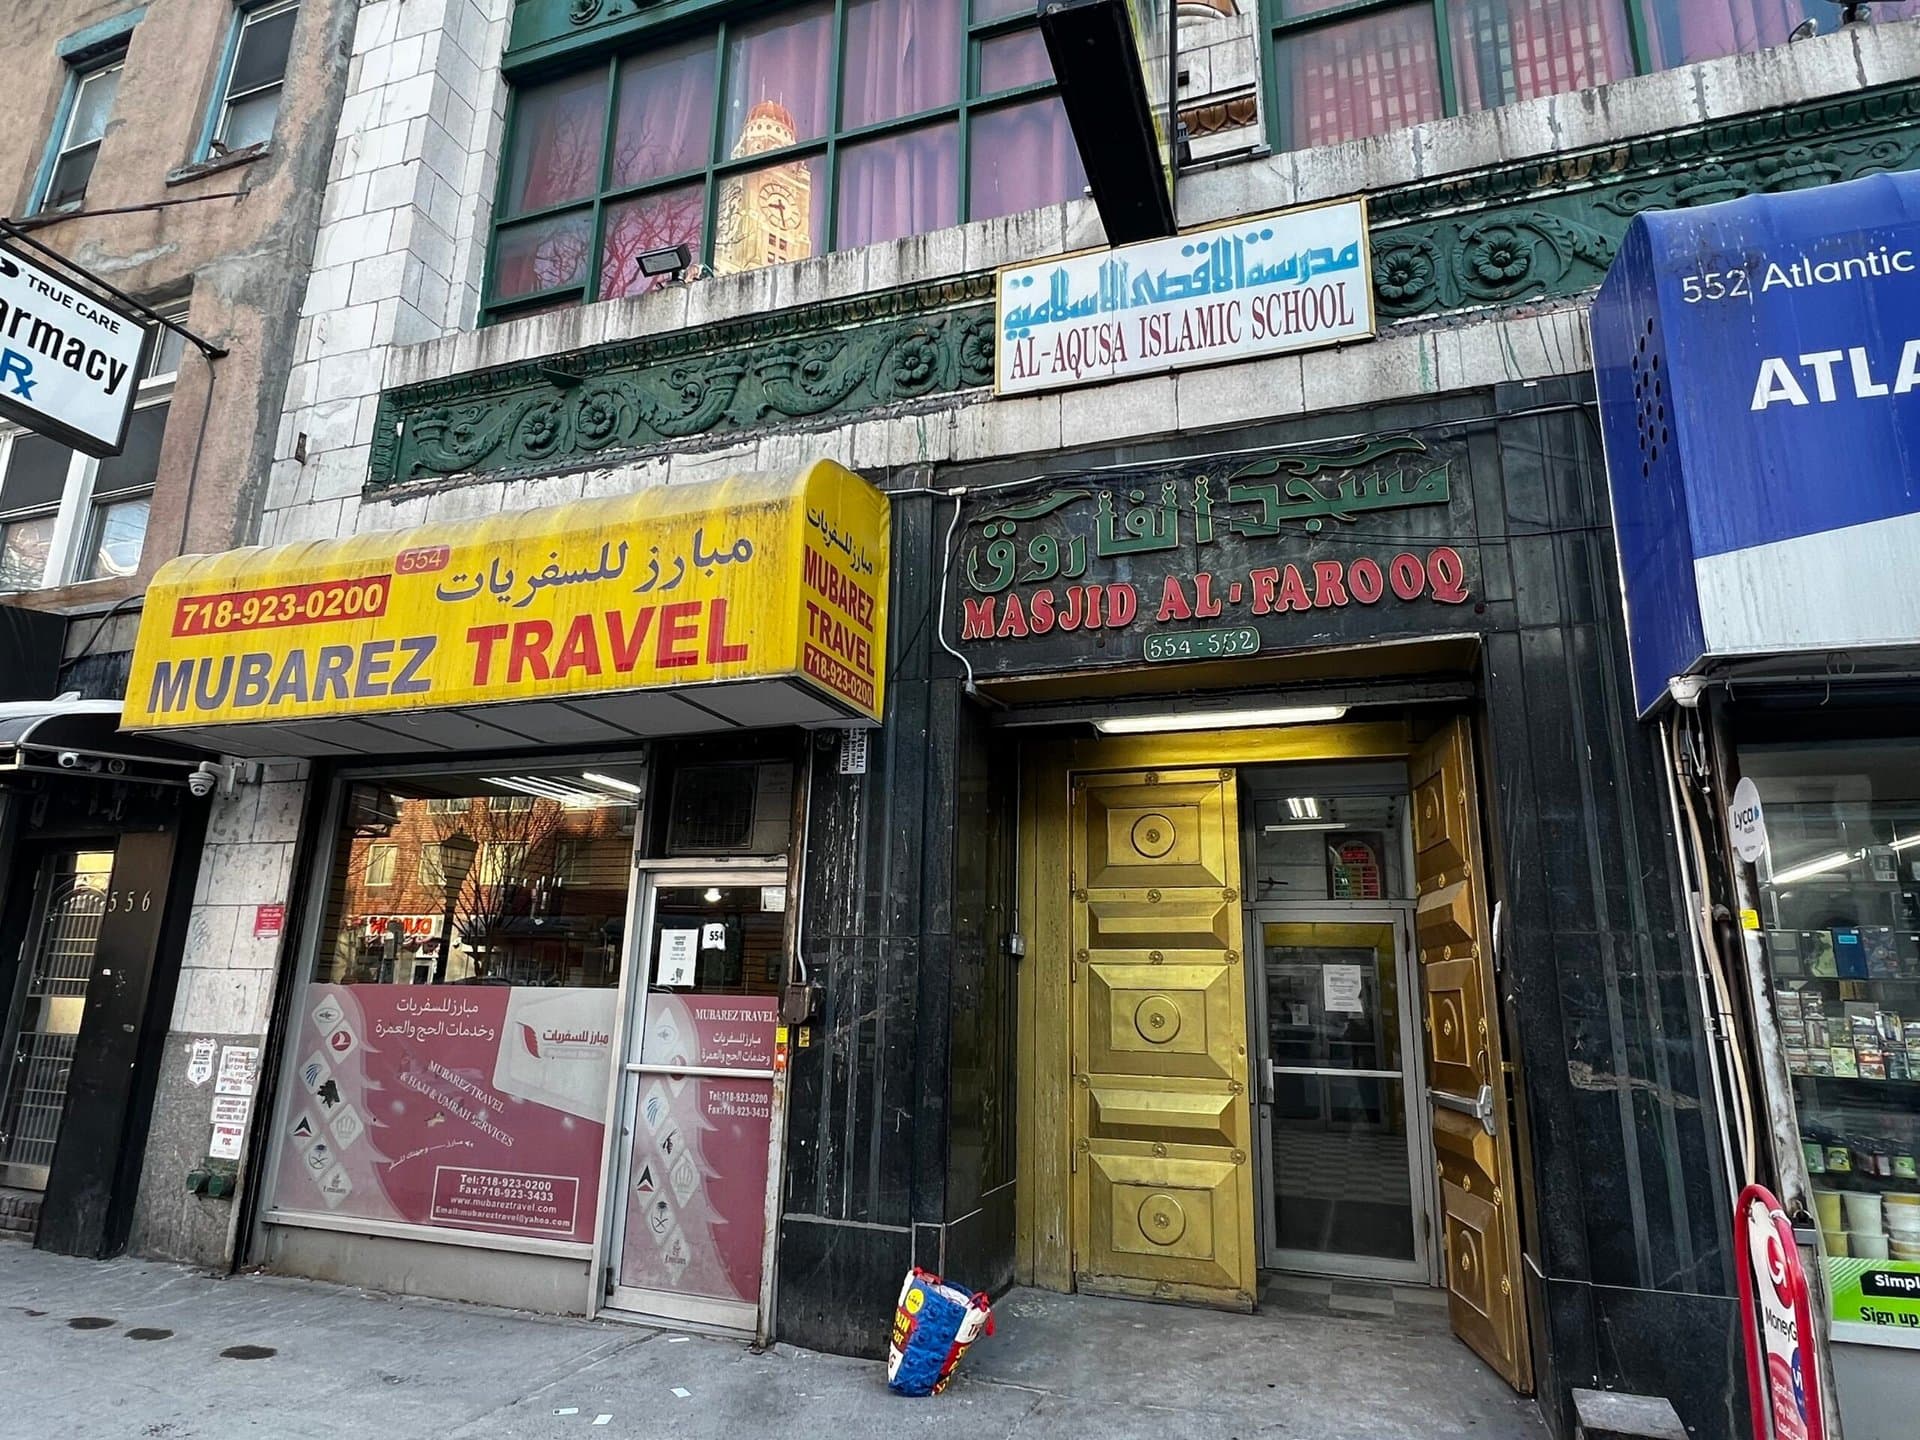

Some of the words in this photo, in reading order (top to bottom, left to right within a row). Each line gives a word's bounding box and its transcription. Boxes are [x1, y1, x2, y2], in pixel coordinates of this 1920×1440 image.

[1682, 268, 1749, 304] 552
[1761, 245, 1917, 292] Atlantic
[27, 274, 74, 309] TRUE
[75, 302, 121, 335] CARE
[1010, 321, 1128, 379] AL-AQUSA
[1139, 300, 1242, 358] ISLAMIC
[1251, 281, 1355, 340] SCHOOL
[402, 551, 442, 572] 554
[435, 540, 628, 608] للسفريات
[633, 527, 755, 594] مبارز
[803, 544, 874, 633] MUBAREZ
[182, 583, 383, 632] 718-923-0200
[961, 583, 1137, 640] MASJID
[146, 635, 438, 715] MUBAREZ
[466, 598, 748, 687] TRAVEL
[806, 600, 875, 677] TRAVEL
[806, 648, 873, 707] 718-923-0200
[108, 889, 152, 912] 556
[416, 1020, 445, 1042] الحج
[446, 1020, 495, 1041] وخدمات
[450, 998, 479, 1018] مبارز
[695, 1008, 739, 1021] MUBAREZ
[740, 1010, 775, 1023] TRAVEL
[427, 1060, 471, 1094] MUBAREZ
[469, 1086, 505, 1114] TRAVEL
[437, 1091, 475, 1122] UMRAH
[472, 1113, 516, 1148] SERVICES
[450, 1197, 557, 1213] www.mubareztravel.com
[1860, 1306, 1896, 1326] Sign
[1899, 1312, 1920, 1328] up
